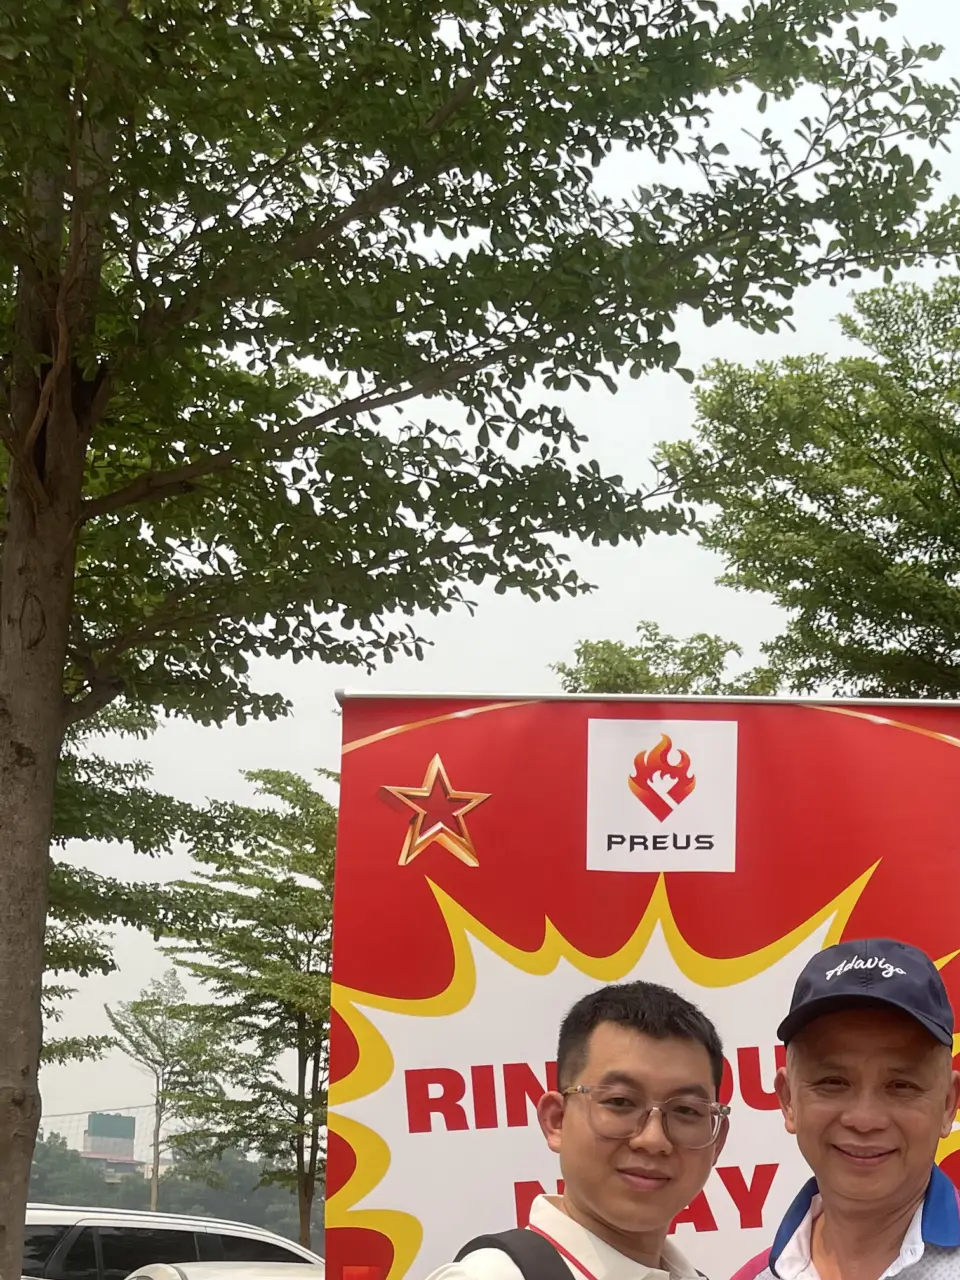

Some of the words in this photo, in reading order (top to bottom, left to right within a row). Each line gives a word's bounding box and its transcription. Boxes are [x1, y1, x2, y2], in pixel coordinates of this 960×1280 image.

[607, 832, 715, 853] PREUS
[404, 1061, 558, 1134] RIN
[514, 1163, 780, 1235] NAY
